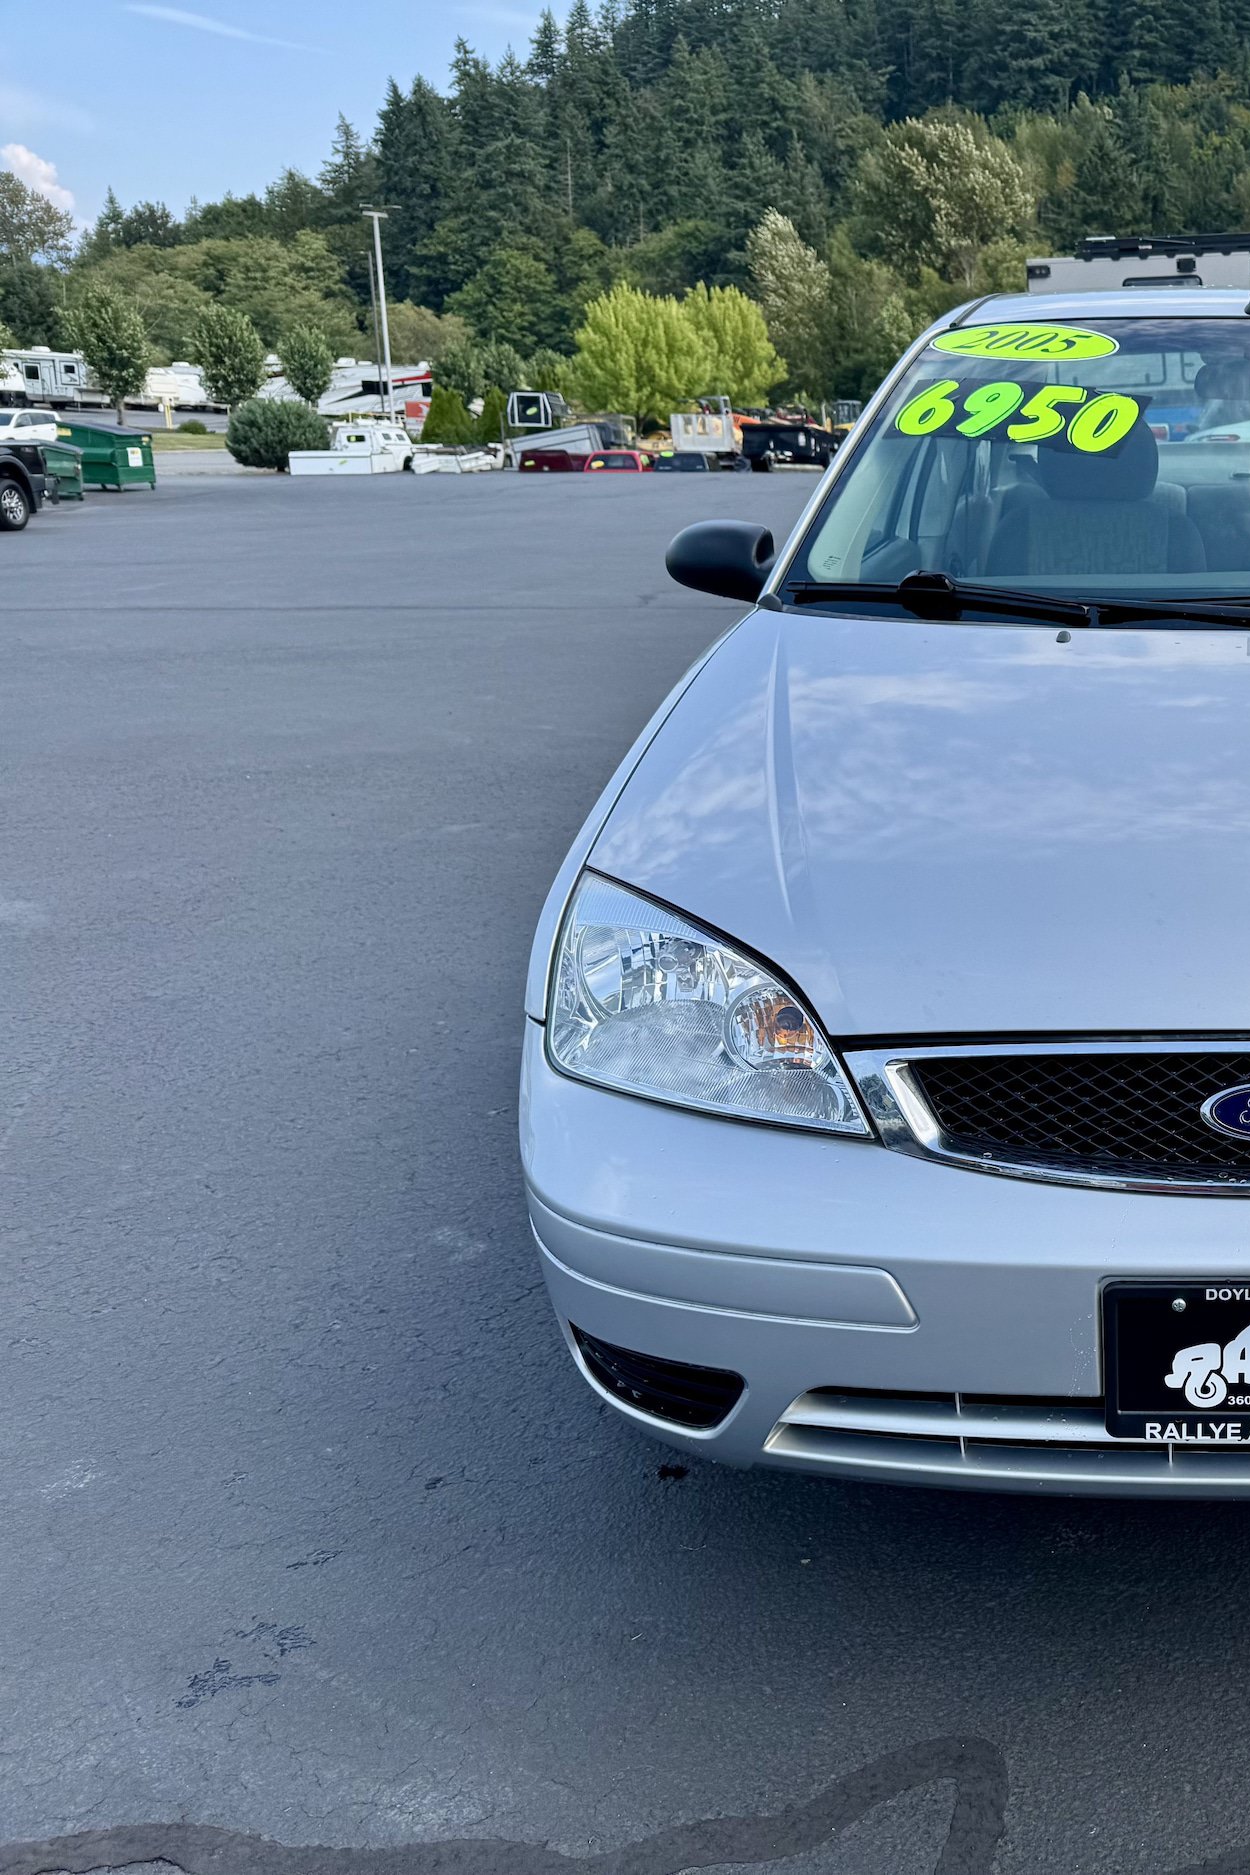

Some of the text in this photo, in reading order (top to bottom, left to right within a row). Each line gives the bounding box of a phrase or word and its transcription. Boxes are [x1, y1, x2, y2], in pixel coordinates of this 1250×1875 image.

[952, 330, 1092, 354] 2005
[895, 379, 1140, 453] 6950
[1145, 1422, 1242, 1441] RALLYE
